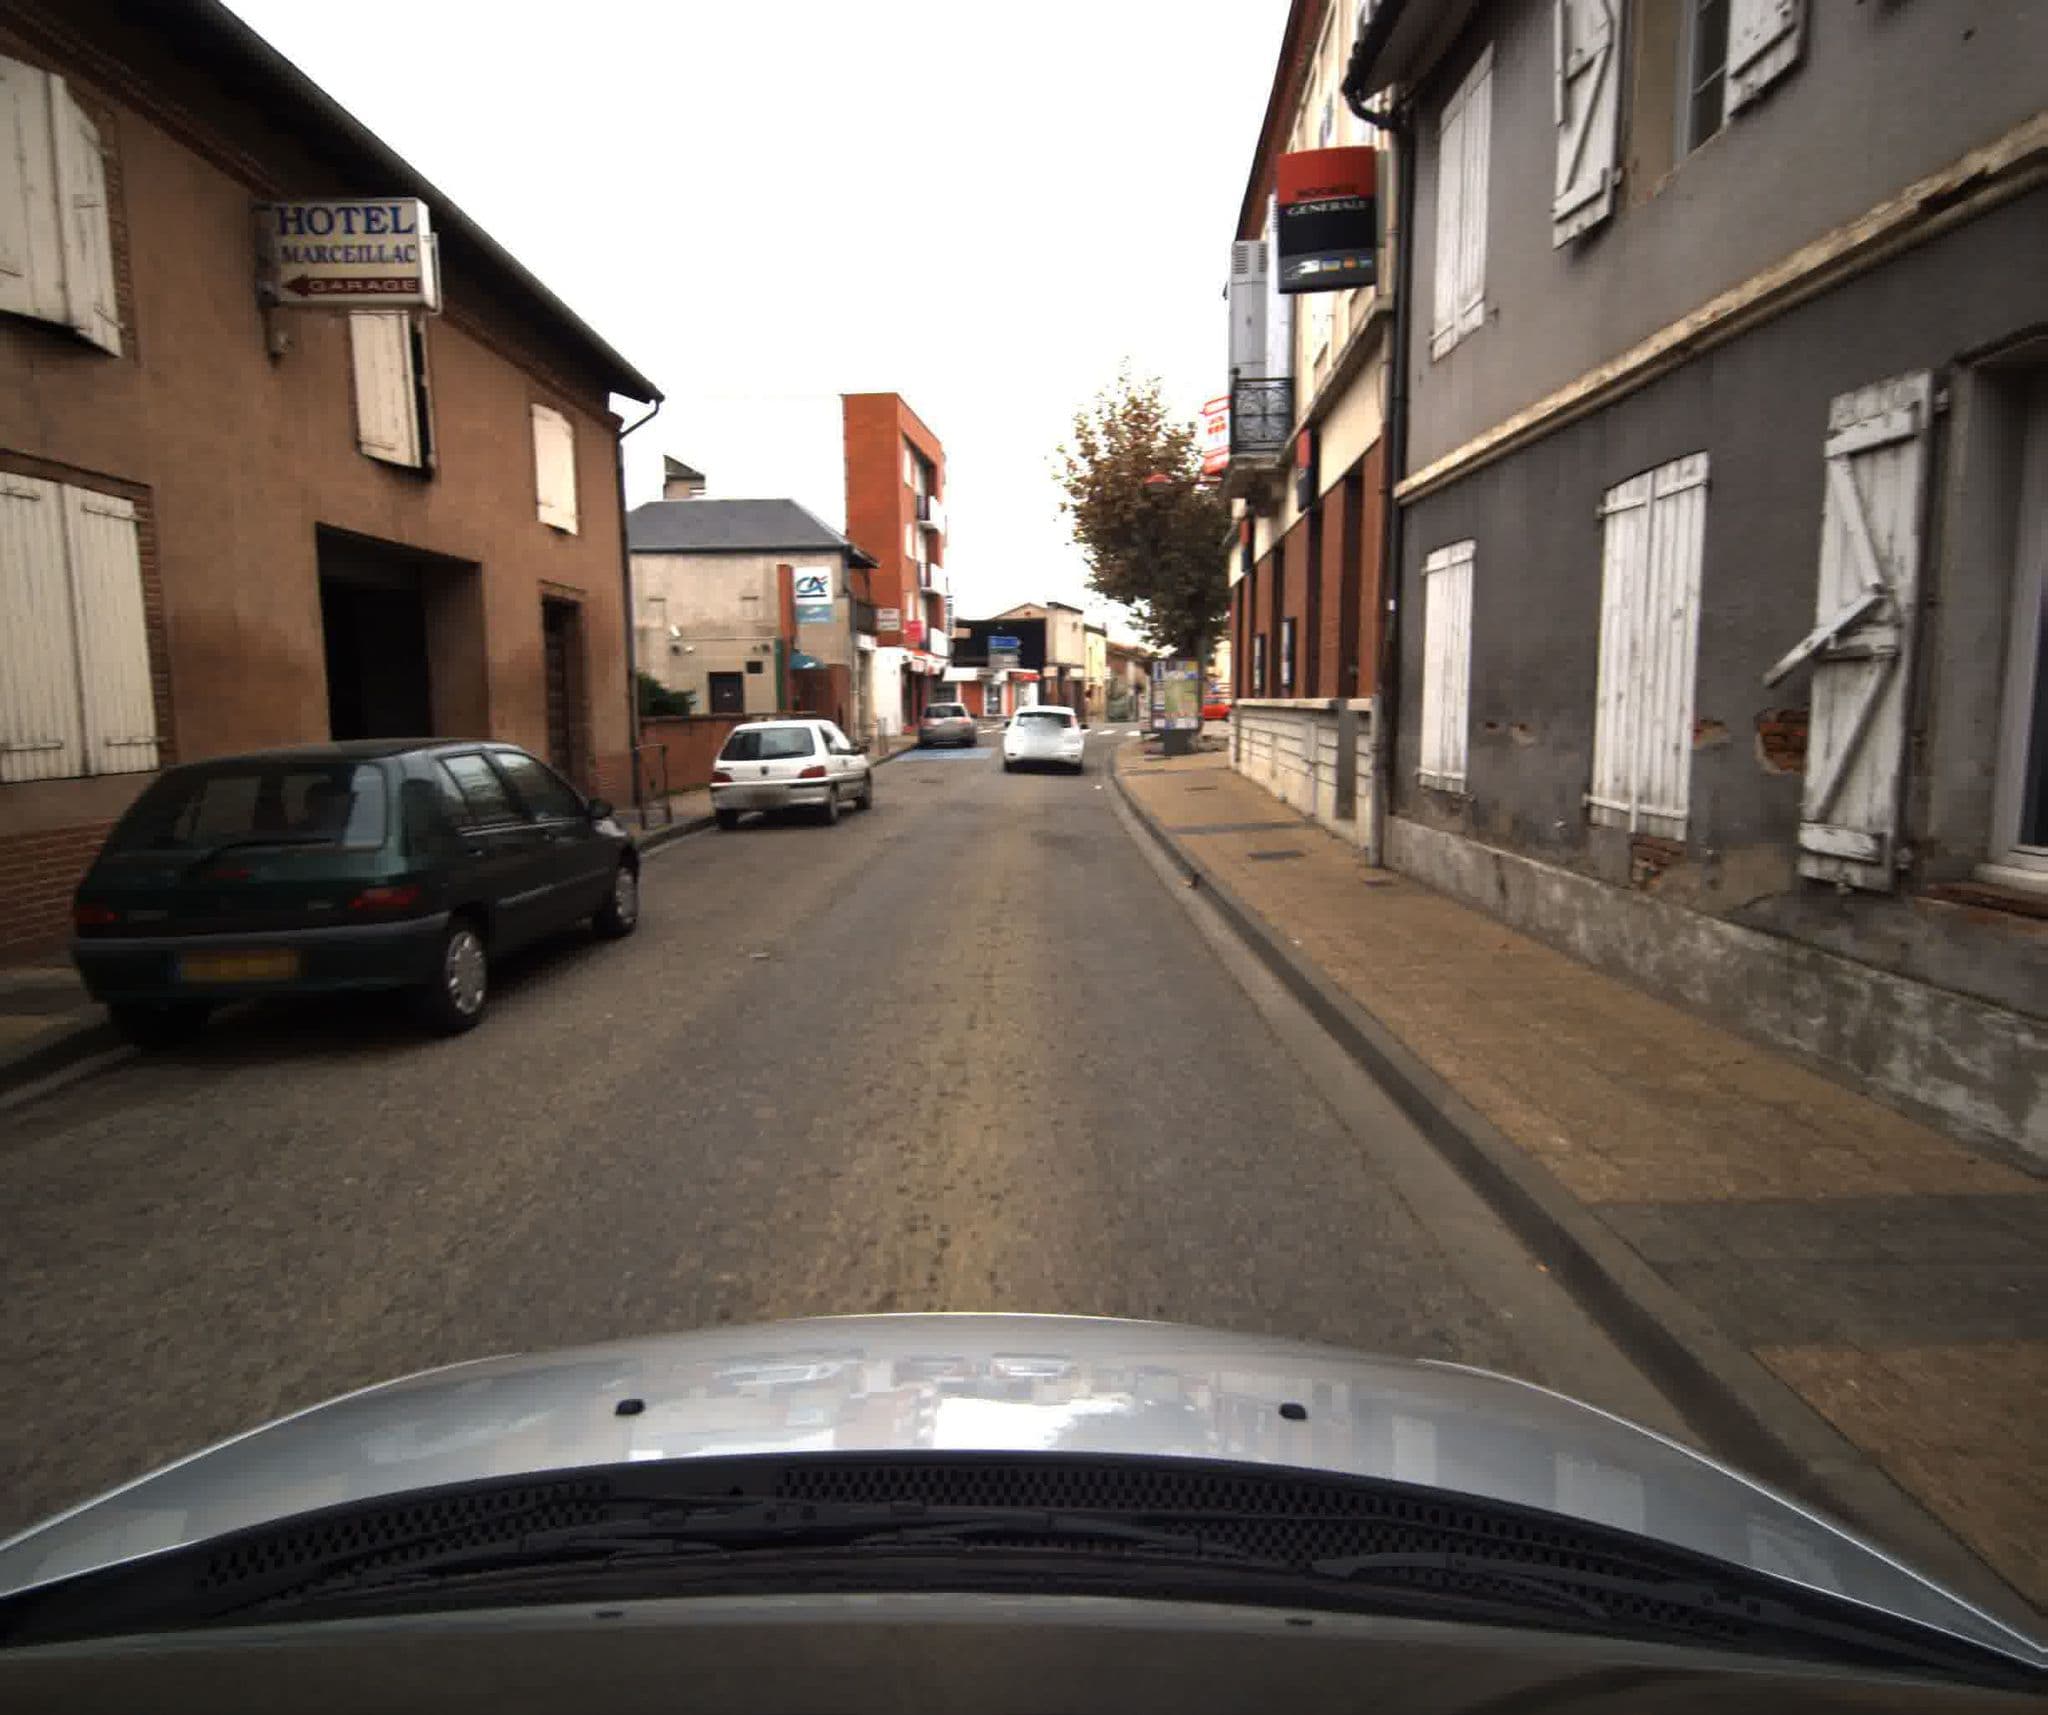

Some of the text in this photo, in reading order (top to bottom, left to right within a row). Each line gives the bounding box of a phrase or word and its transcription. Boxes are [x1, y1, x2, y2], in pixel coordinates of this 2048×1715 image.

[279, 206, 415, 235] HOTEL
[280, 244, 416, 264] MARCEILLAC
[308, 279, 416, 292] GARAGE
